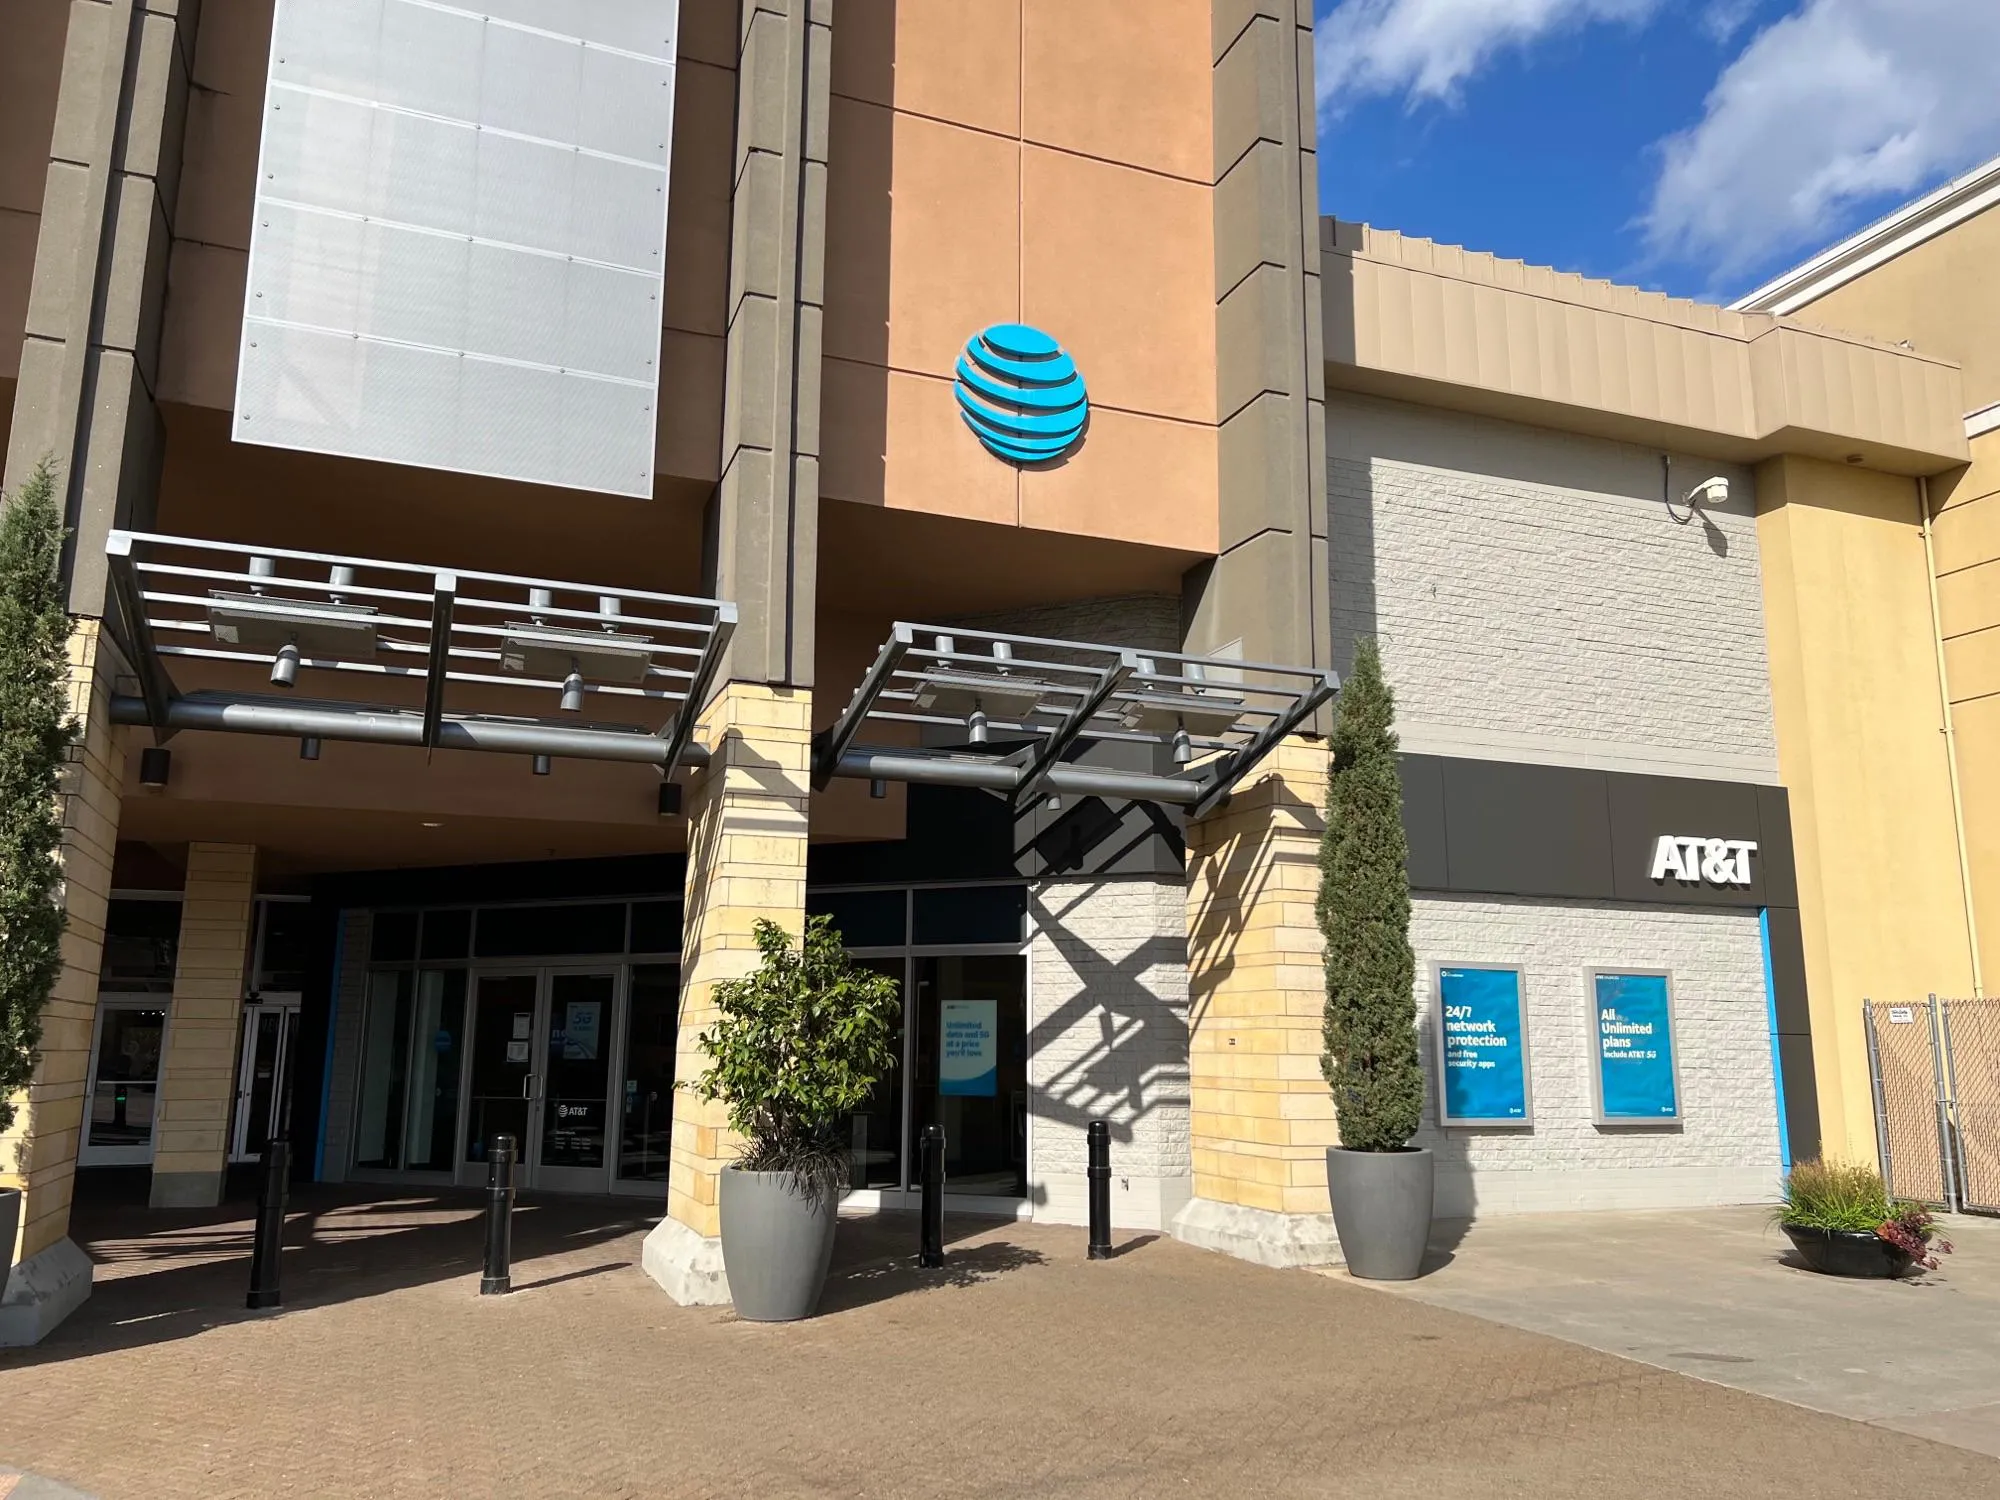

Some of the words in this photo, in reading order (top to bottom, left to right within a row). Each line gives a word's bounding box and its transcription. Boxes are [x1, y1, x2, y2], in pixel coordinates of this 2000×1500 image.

[1650, 835, 1757, 884] AT&T
[1445, 1005, 1472, 1020] 24/7
[1601, 1008, 1616, 1020] All
[946, 1021, 982, 1030] Unlimited
[1446, 1019, 1497, 1033] network
[1601, 1022, 1653, 1035] Unlimited
[964, 1030, 978, 1039] and
[961, 1040, 980, 1050] price
[1447, 1034, 1508, 1049] protection
[1602, 1035, 1631, 1050] plans
[1447, 1050, 1462, 1058] and
[1463, 1049, 1478, 1058] free
[1628, 1050, 1646, 1059] AT&T
[1448, 1059, 1478, 1069] security
[1478, 1060, 1496, 1070] apps
[568, 1106, 588, 1116] AT&T
